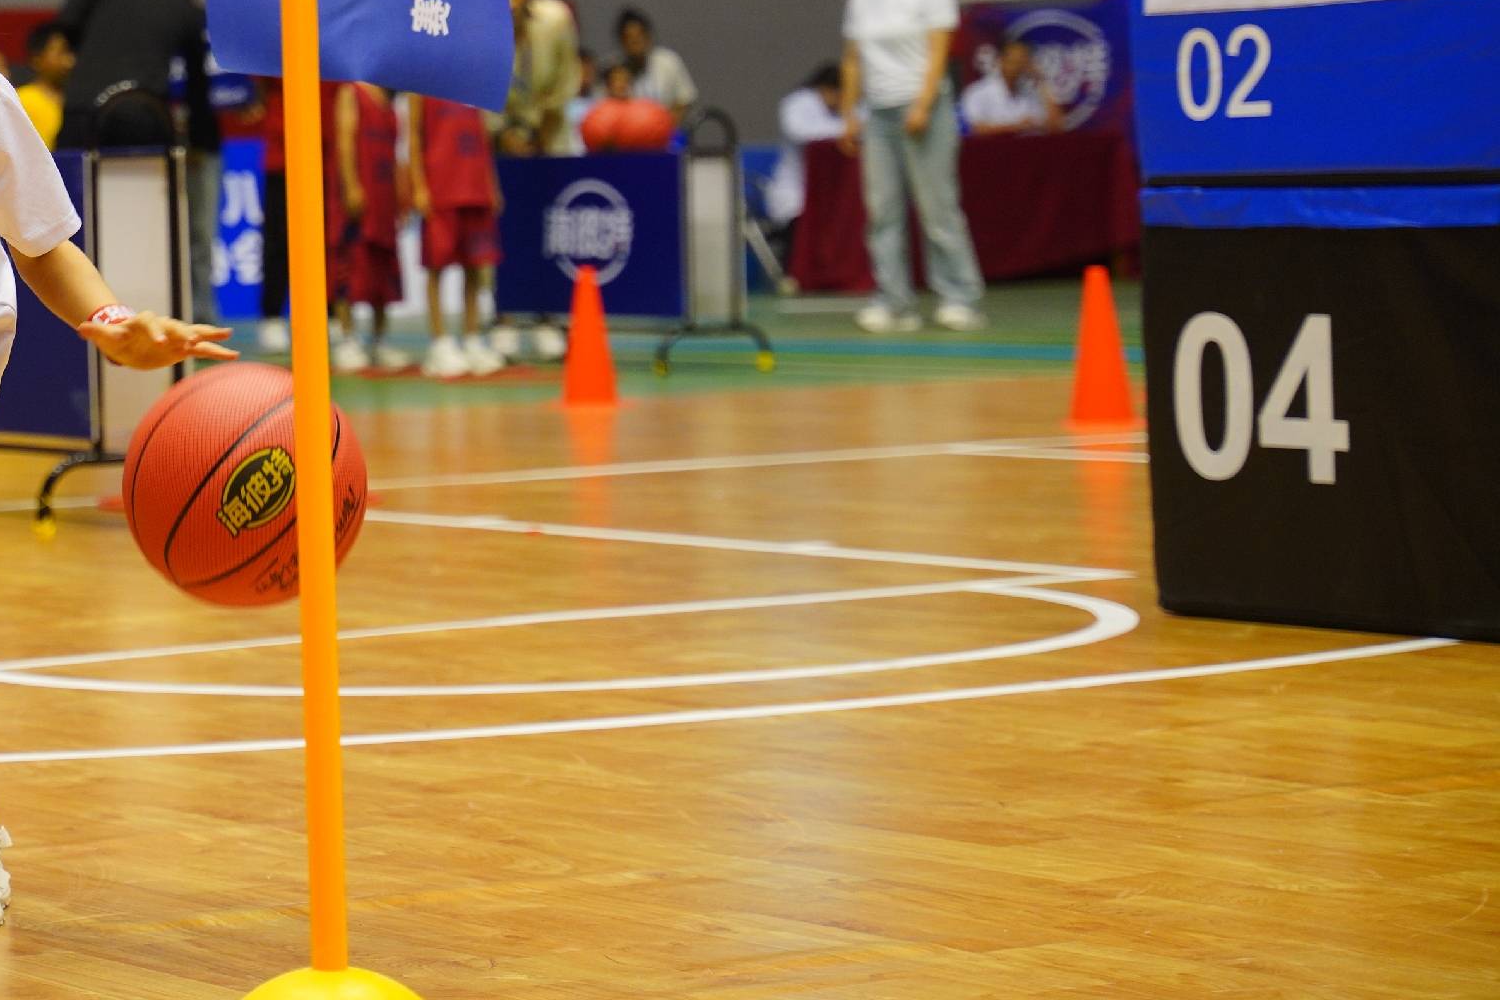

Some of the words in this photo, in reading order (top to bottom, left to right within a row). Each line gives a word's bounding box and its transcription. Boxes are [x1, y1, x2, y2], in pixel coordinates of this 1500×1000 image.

[1176, 23, 1272, 121] 02
[1173, 311, 1350, 485] 04
[216, 446, 296, 538] 海彼特
